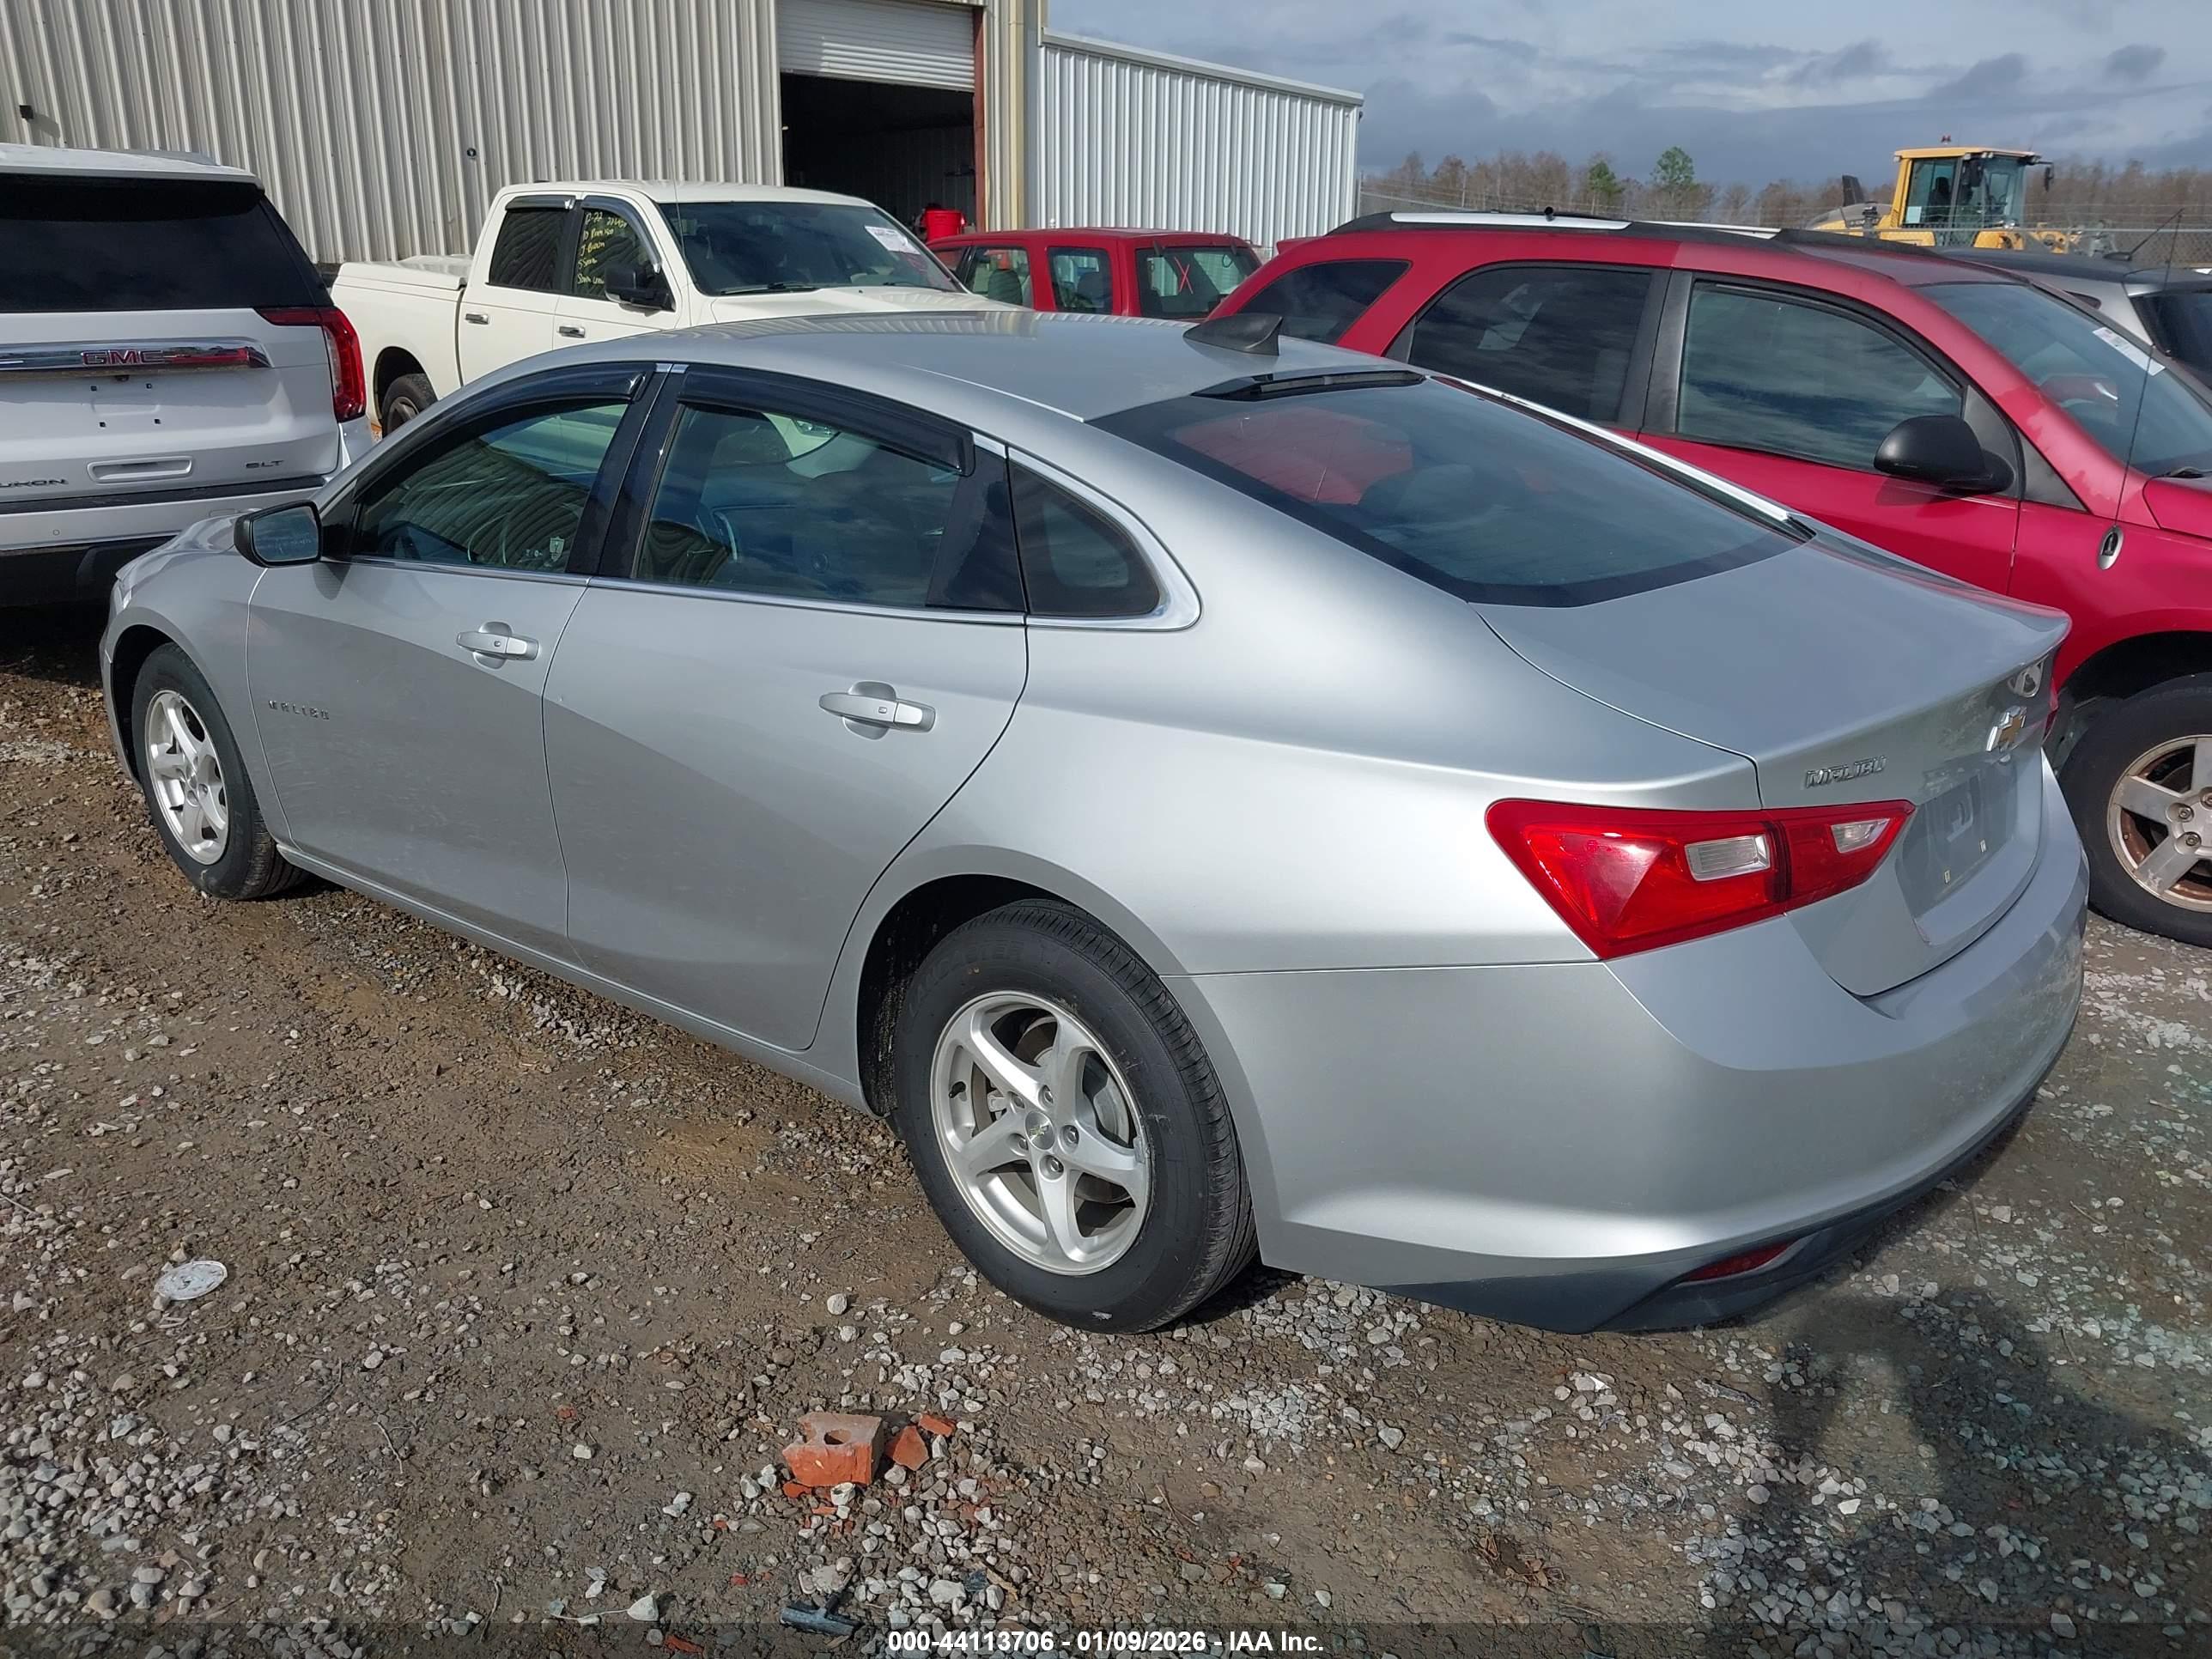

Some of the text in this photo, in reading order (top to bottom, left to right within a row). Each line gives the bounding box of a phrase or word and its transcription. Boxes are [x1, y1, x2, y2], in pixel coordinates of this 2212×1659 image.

[81, 349, 165, 367] GMC
[0, 478, 69, 489] UKON
[1805, 756, 1887, 788] MALIBU
